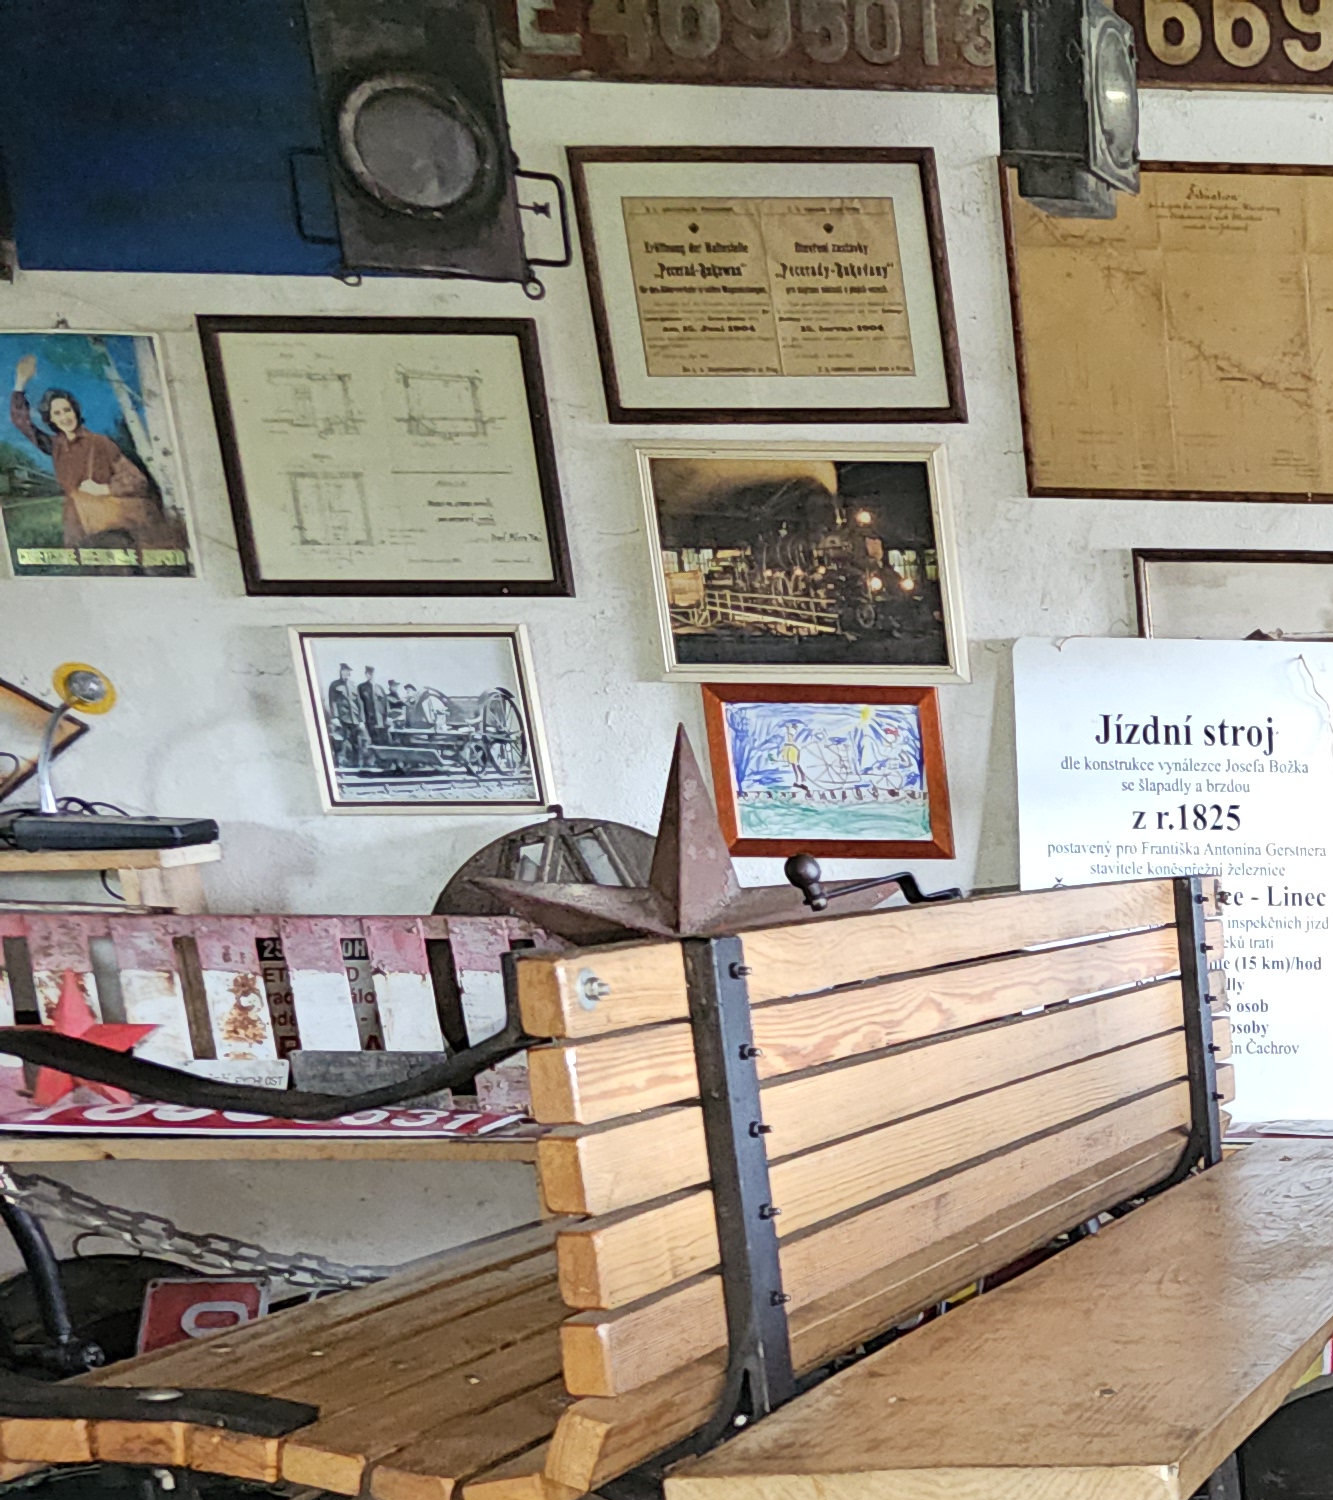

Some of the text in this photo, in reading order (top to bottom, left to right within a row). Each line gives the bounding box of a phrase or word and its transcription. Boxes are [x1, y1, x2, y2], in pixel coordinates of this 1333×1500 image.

[1095, 713, 1275, 756] Jízdní stroj
[1060, 756, 1309, 775] dle konstrukce vynálezce Josefa Božka
[1121, 778, 1251, 795] se šlapadly a brzdou
[1132, 804, 1241, 831] z r.1825
[1047, 841, 1113, 858] postavený
[1116, 845, 1138, 858] pro
[1141, 841, 1200, 856] Františka
[1265, 843, 1327, 857] Gerstnera
[1090, 862, 1143, 876] stavitele
[1228, 862, 1286, 877] železnice
[1267, 886, 1327, 907] Linec
[1235, 956, 1257, 973] (15
[1262, 957, 1322, 973] km)/hod
[1236, 999, 1269, 1013] osob
[1246, 1038, 1300, 1055] Čachrov
